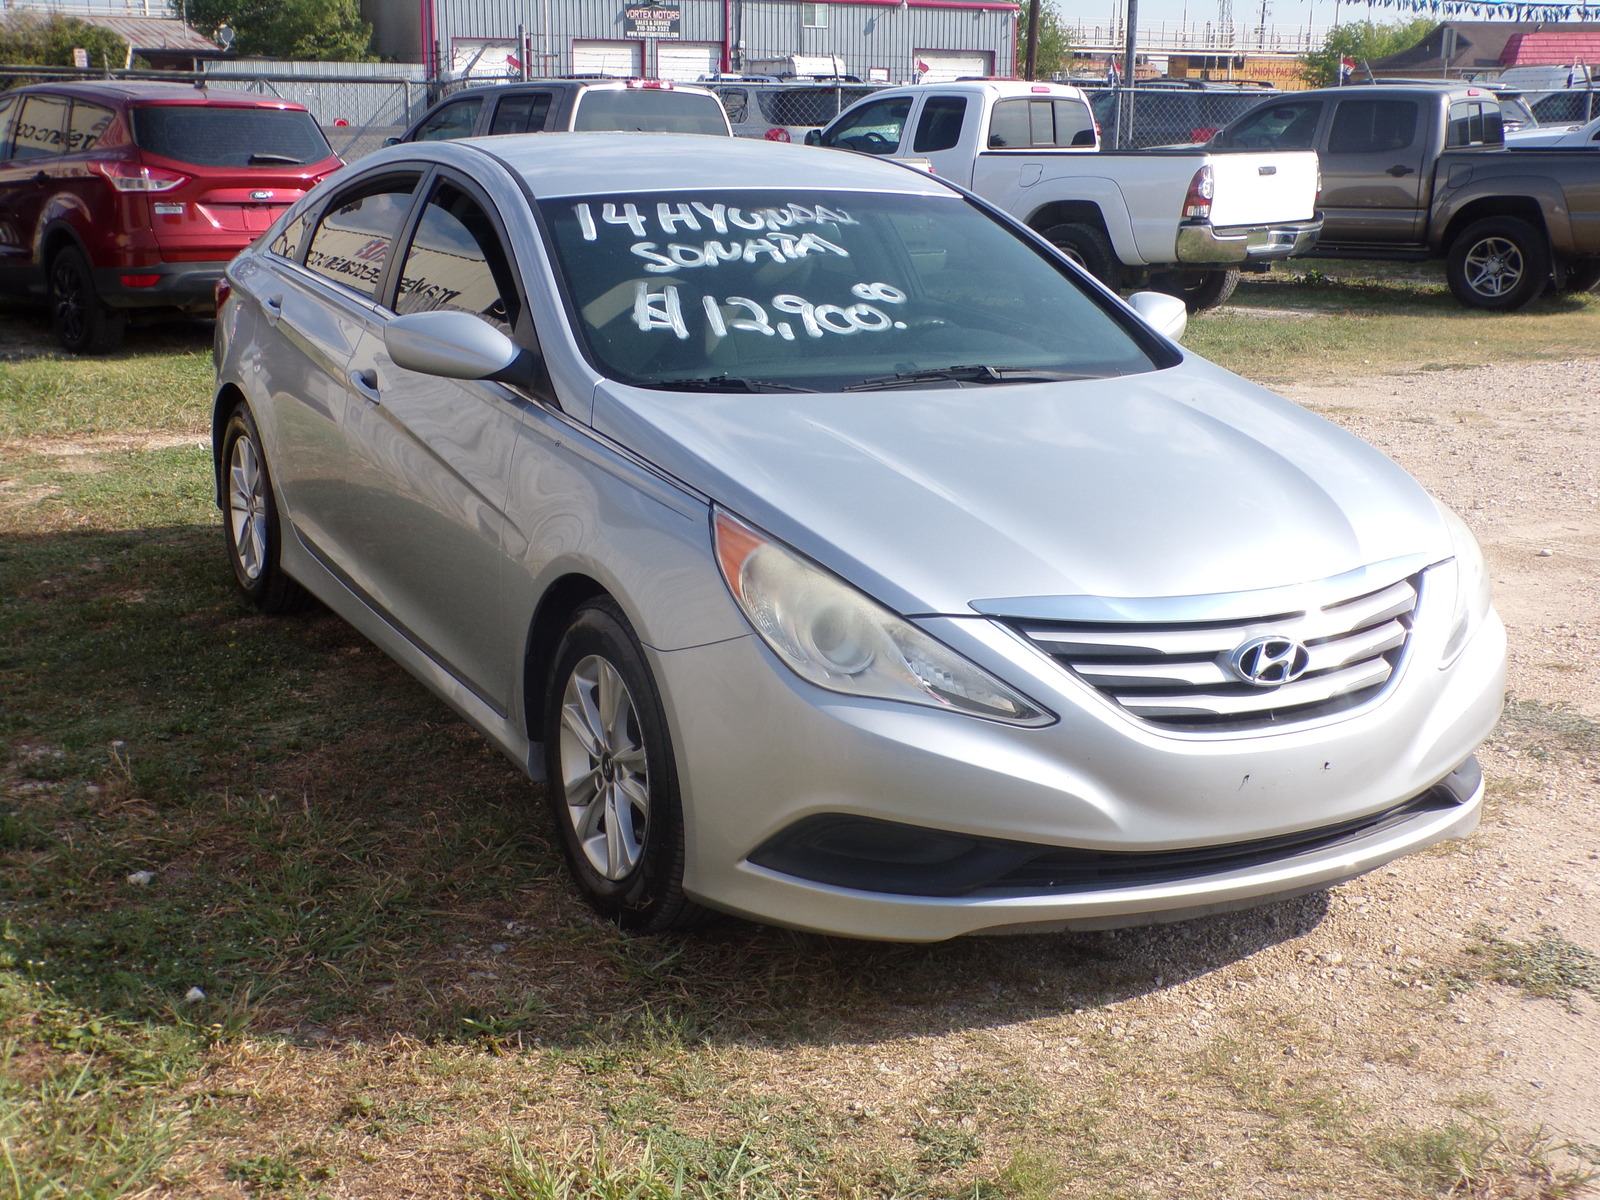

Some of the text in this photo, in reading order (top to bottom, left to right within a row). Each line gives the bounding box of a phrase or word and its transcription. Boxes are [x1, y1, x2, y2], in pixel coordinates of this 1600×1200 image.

[625, 9, 680, 20] VORTEX MOTORS
[1249, 67, 1274, 76] UNION
[572, 202, 647, 241] 14
[629, 231, 850, 272] SONATA
